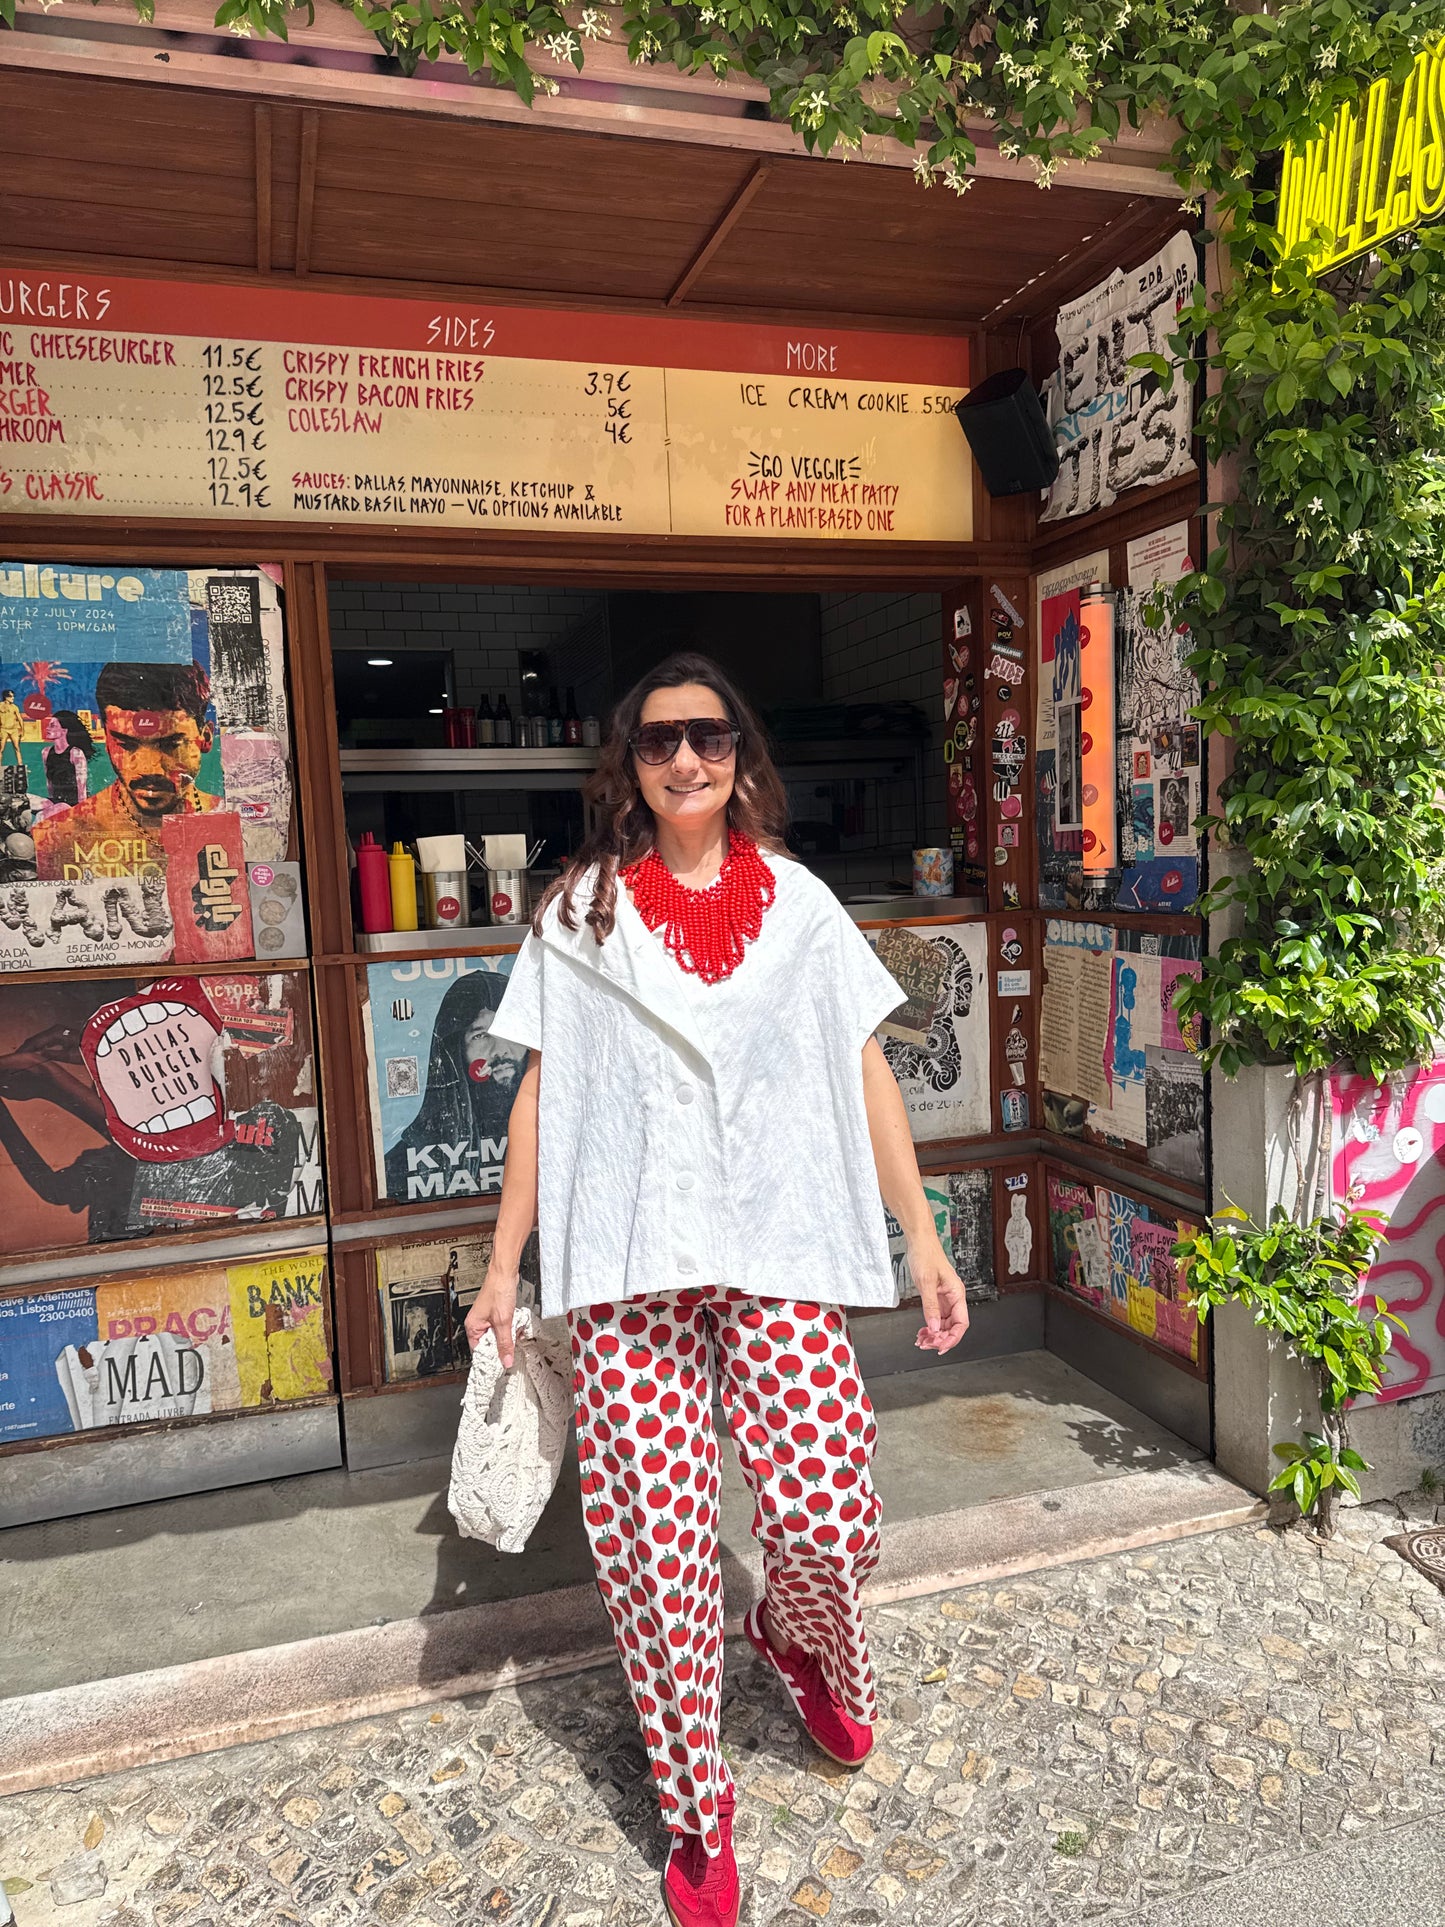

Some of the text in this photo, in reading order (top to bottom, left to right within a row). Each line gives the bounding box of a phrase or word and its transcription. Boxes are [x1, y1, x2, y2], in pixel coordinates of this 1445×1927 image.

[426, 315, 496, 349] SIDES
[30, 332, 176, 367] CHEESEBURGER
[202, 344, 263, 372] 11.5€
[786, 341, 839, 373] MORE
[203, 374, 264, 398] 12.5€
[283, 349, 631, 396] CRISPY FRENCH FRIES 3.9€
[285, 376, 632, 418] CRISPY BACON FRIES 5€
[740, 383, 768, 407] ICE
[788, 387, 849, 411] CREAM
[857, 392, 910, 414] COOKIE
[205, 401, 265, 426] 12.5€
[288, 407, 633, 444] COLESLAW 4€
[208, 457, 268, 481] 12.5€
[761, 454, 848, 481] GO VEGGIE
[26, 471, 104, 501] CLASSIC
[209, 482, 271, 508] 12.9€
[291, 471, 351, 490] SAUCES:
[510, 479, 575, 499] KETCHUP
[731, 478, 900, 507] SWAP ANY MEAT PATTY
[365, 495, 407, 513] BASIL
[410, 497, 447, 515] MAYO
[468, 499, 489, 516] VG
[493, 500, 550, 519] OPTIONS
[554, 502, 624, 523] AVAILABLE
[726, 503, 895, 531] FOR A PLANT-BASED ONE
[25, 606, 39, 617] 12
[85, 609, 115, 620] 2024
[56, 621, 116, 633] 10PM/6AM
[74, 838, 152, 863] MOTEL
[13, 948, 29, 958] DA
[66, 944, 79, 954] 15
[79, 943, 93, 953] DE
[94, 942, 120, 952] MAIO
[128, 940, 166, 950] MONICA
[66, 953, 117, 965] GAGLIANO
[118, 1023, 190, 1067] DALLAS
[128, 1046, 203, 1089] BURGER
[151, 1072, 200, 1105] CLUB
[433, 1237, 459, 1246] LOCO
[262, 1263, 286, 1276] THE
[20, 1303, 55, 1316] Lisboa
[37, 1288, 95, 1304] Afterhours.
[39, 1307, 95, 1323] 2300-0400
[105, 1347, 205, 1406] MAD
